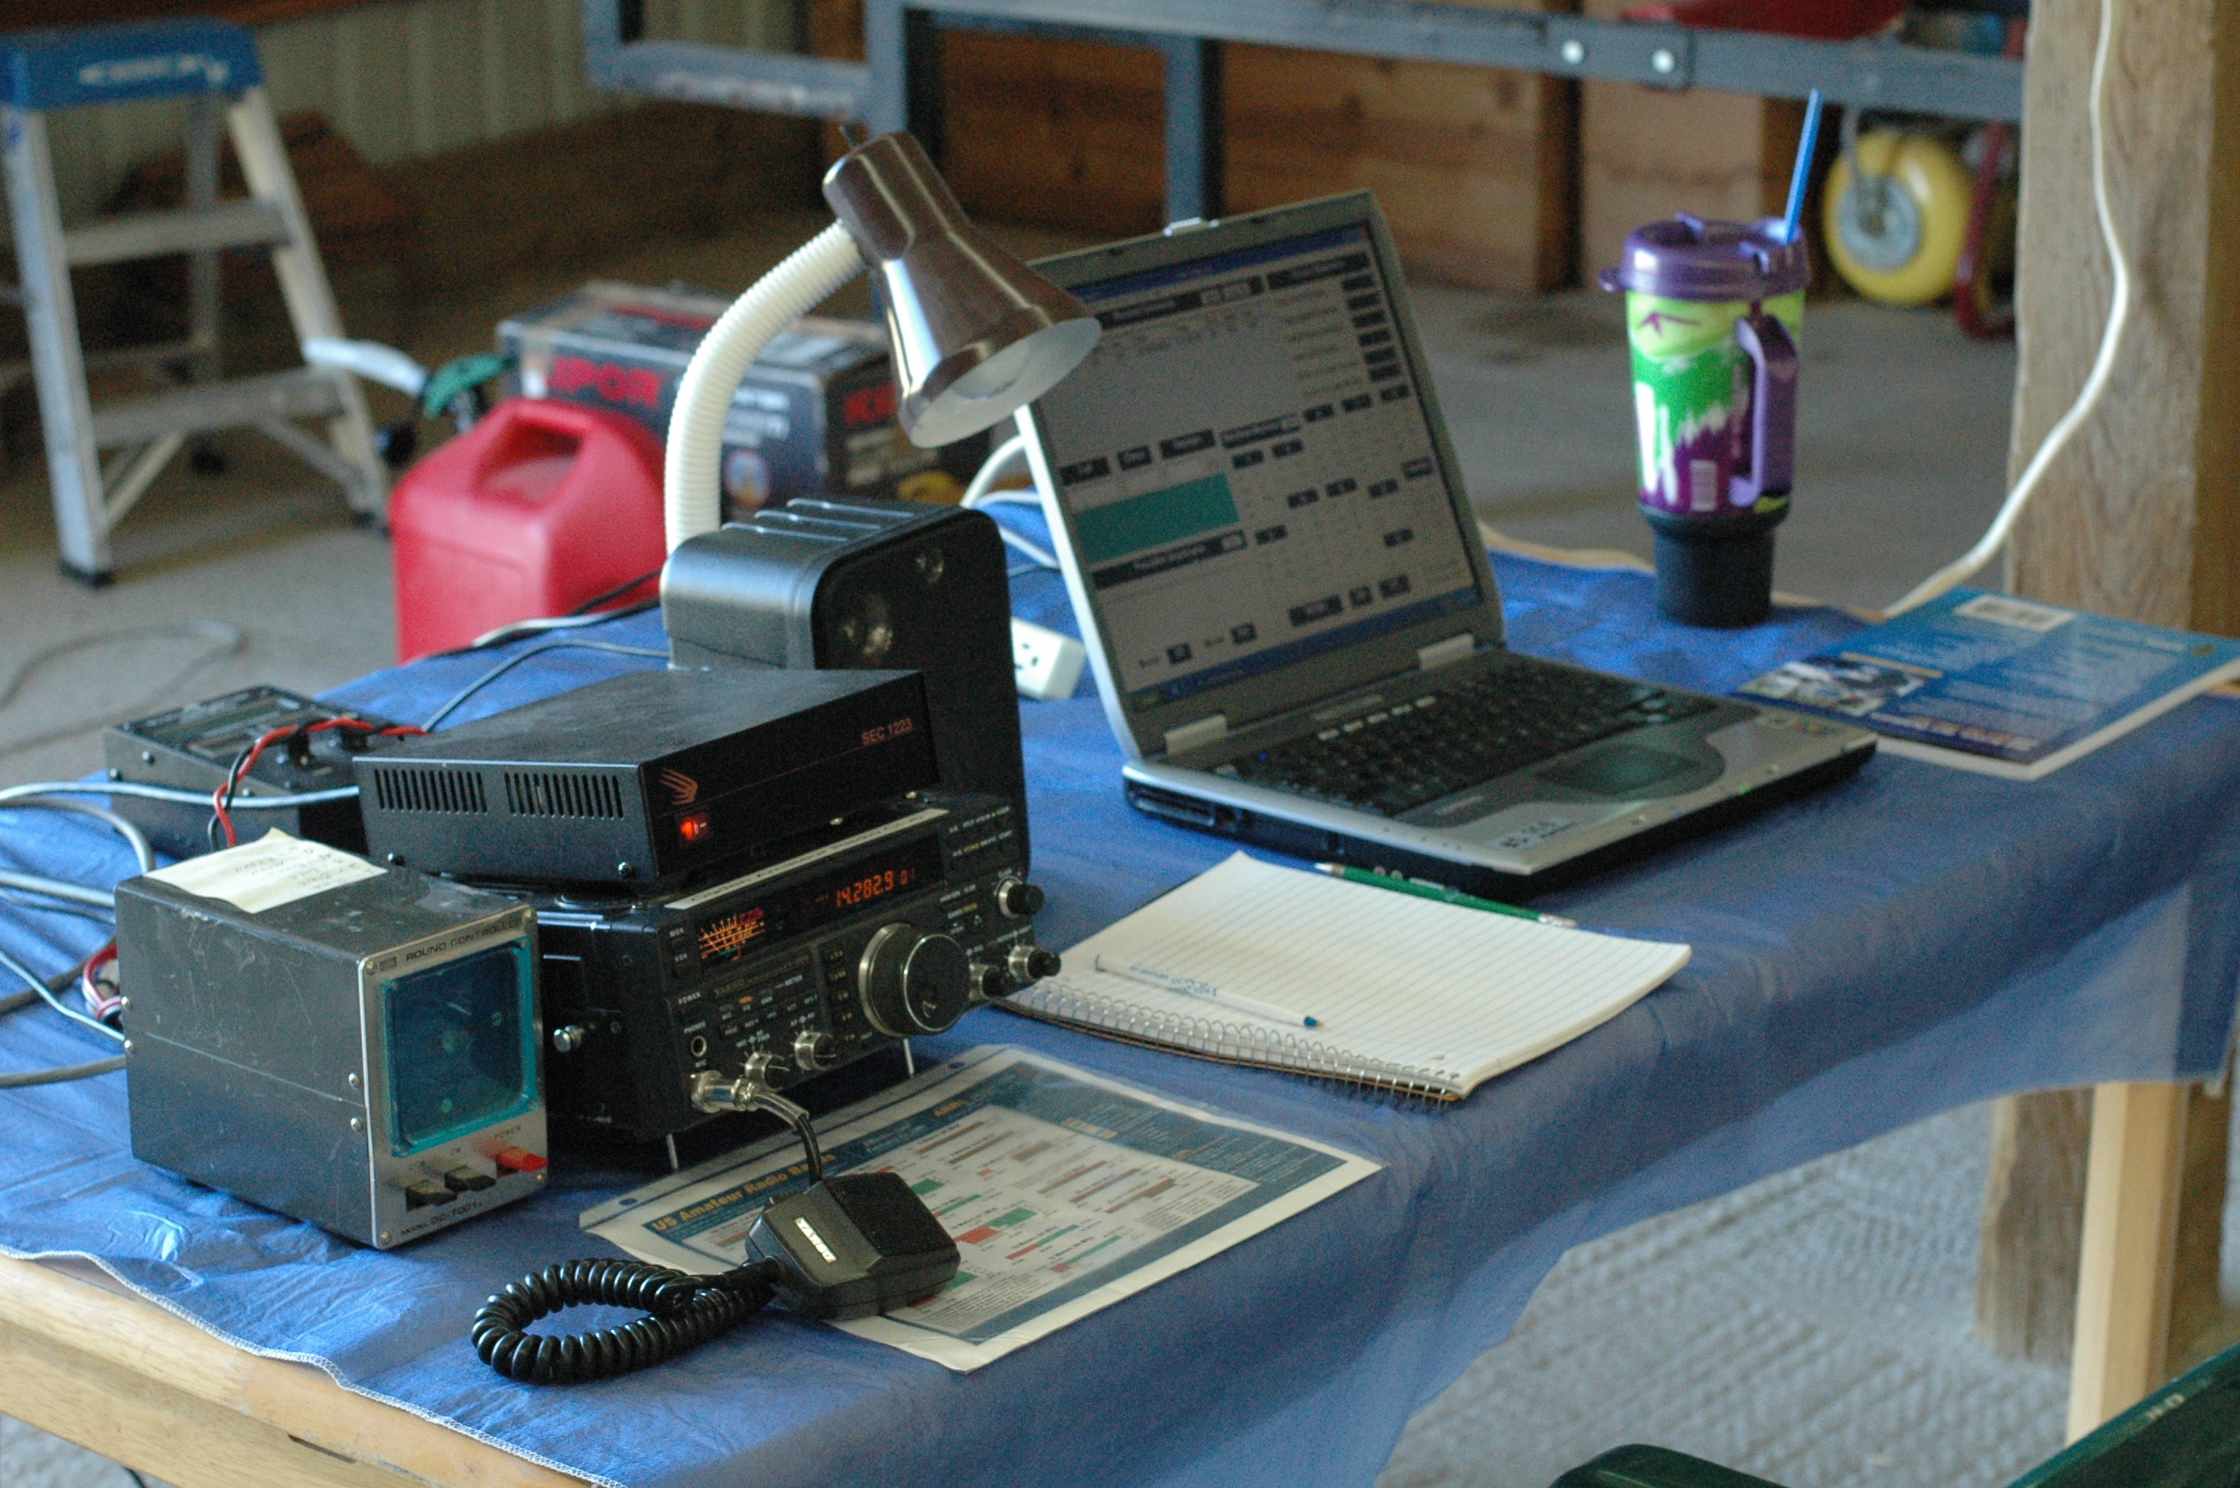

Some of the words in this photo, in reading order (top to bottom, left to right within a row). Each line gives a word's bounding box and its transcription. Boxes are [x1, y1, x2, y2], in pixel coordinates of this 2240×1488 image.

[862, 726, 887, 747] SEC
[654, 1214, 678, 1232] US
[679, 1190, 744, 1222] Amateur
[744, 1171, 788, 1195] Radio
[787, 1153, 835, 1177] Bas
